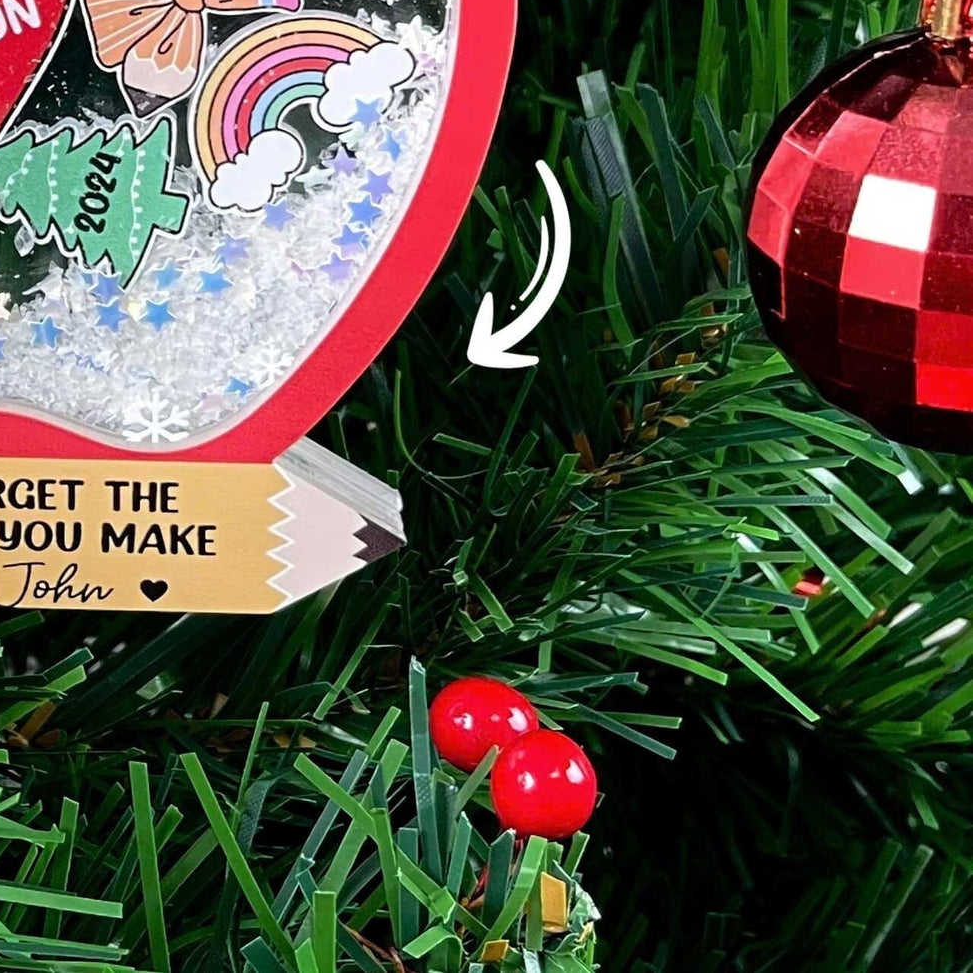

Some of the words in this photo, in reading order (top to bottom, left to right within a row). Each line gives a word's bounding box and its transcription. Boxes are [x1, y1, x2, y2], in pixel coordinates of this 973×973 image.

[73, 151, 122, 234] 2024
[104, 480, 179, 514] THE
[101, 522, 217, 556] MAKE
